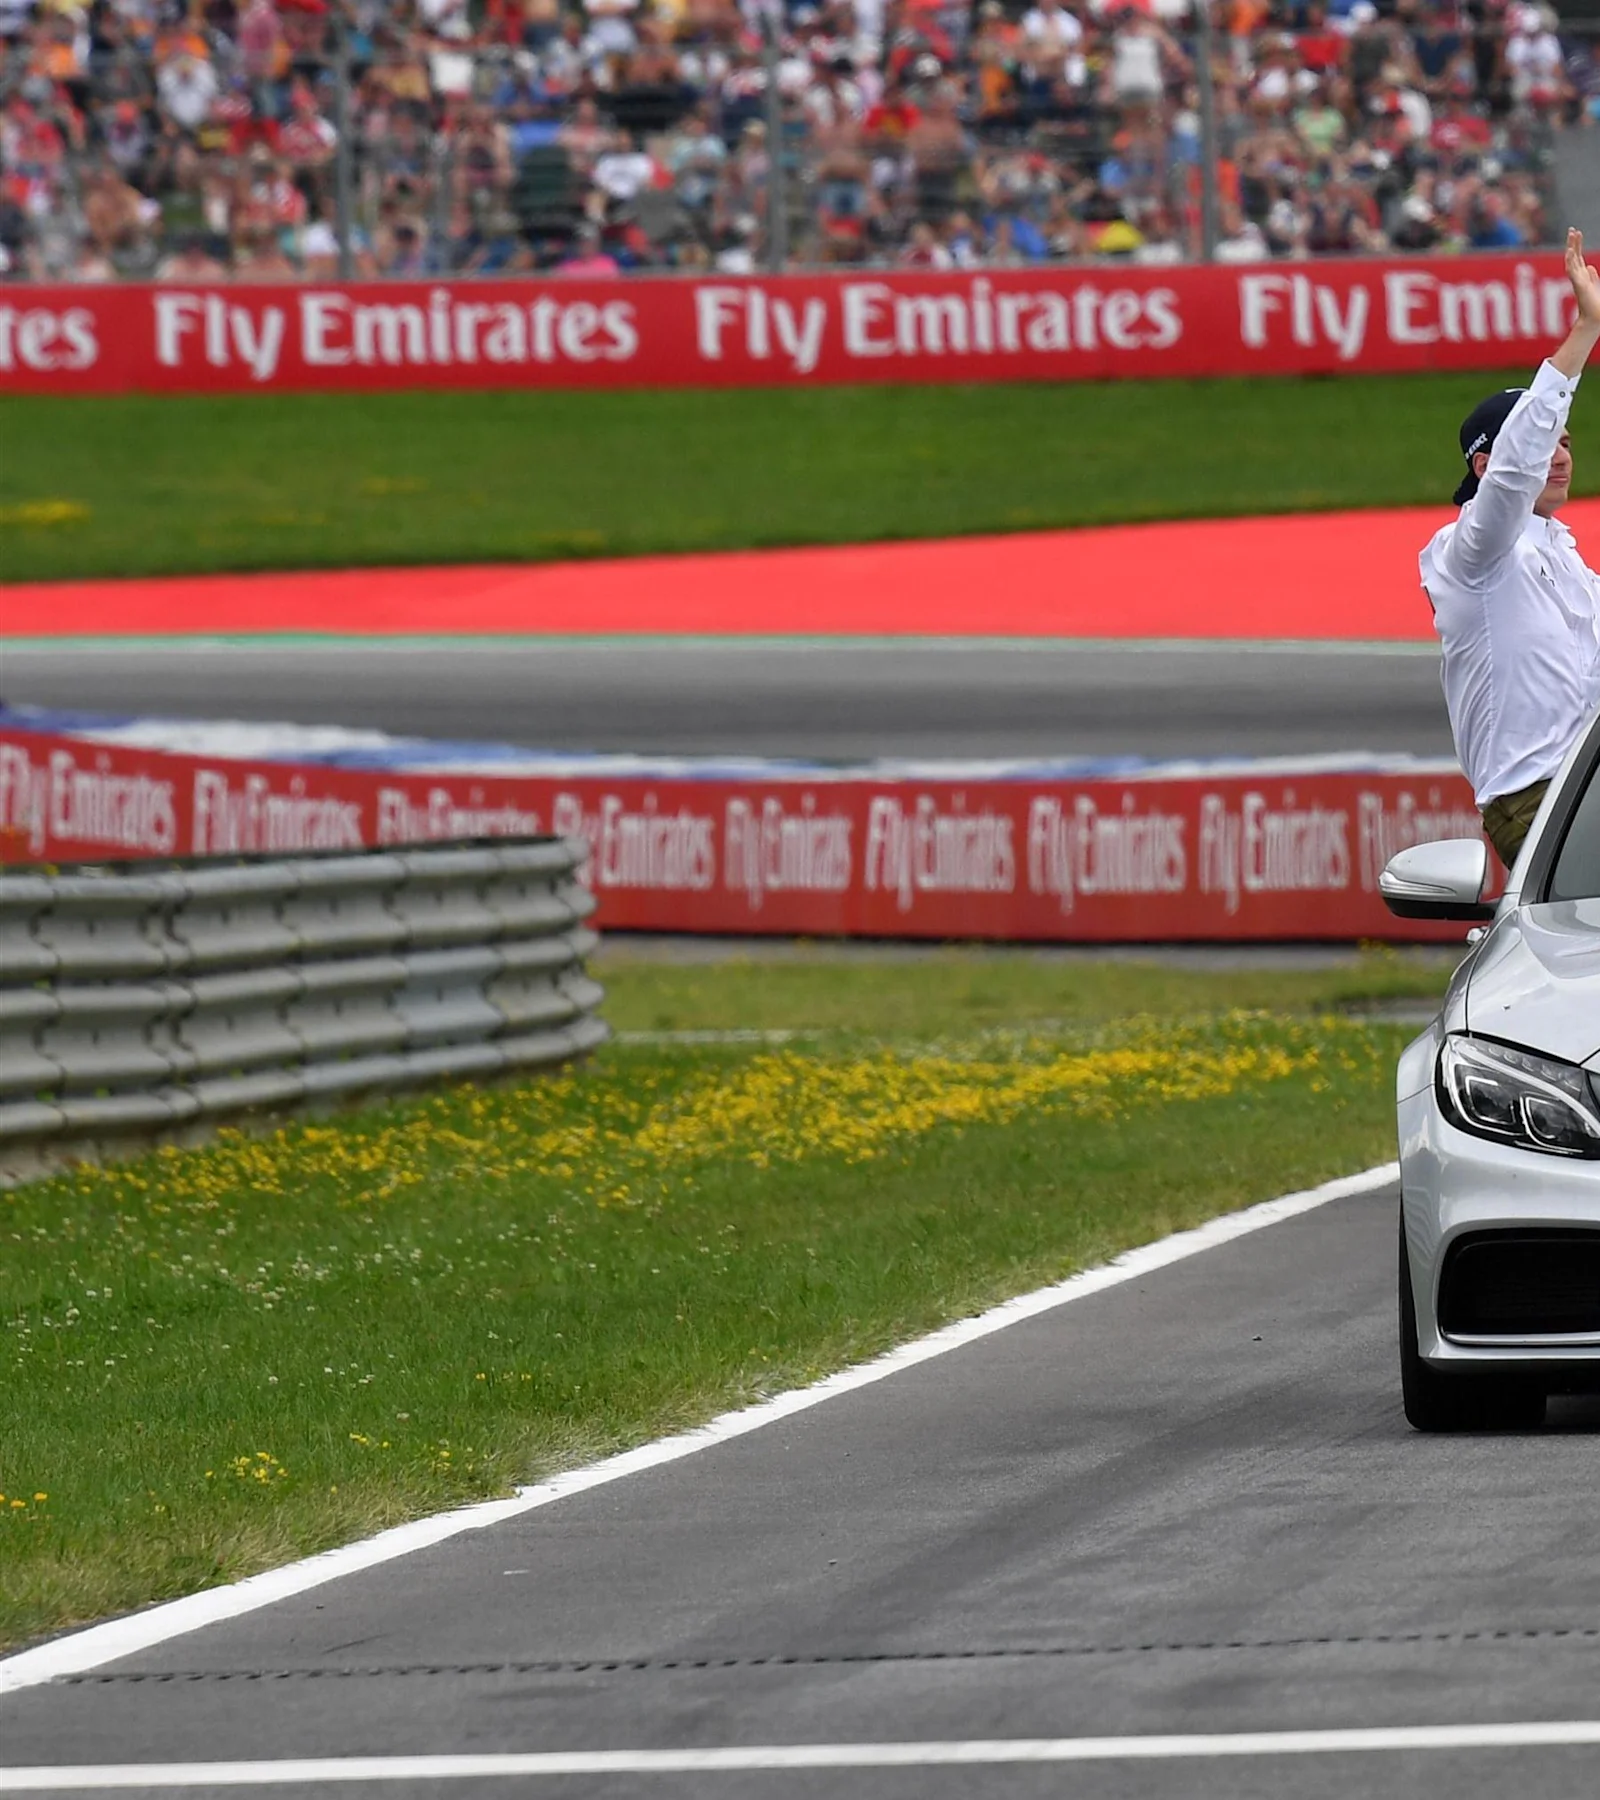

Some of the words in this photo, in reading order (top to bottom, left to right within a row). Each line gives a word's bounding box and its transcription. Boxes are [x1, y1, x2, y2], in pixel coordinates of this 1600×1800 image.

[155, 292, 284, 381] Fly
[301, 287, 639, 367] Emirates
[695, 286, 826, 373] Fly
[841, 277, 1183, 357] Emirates
[1240, 274, 1369, 360] Fly
